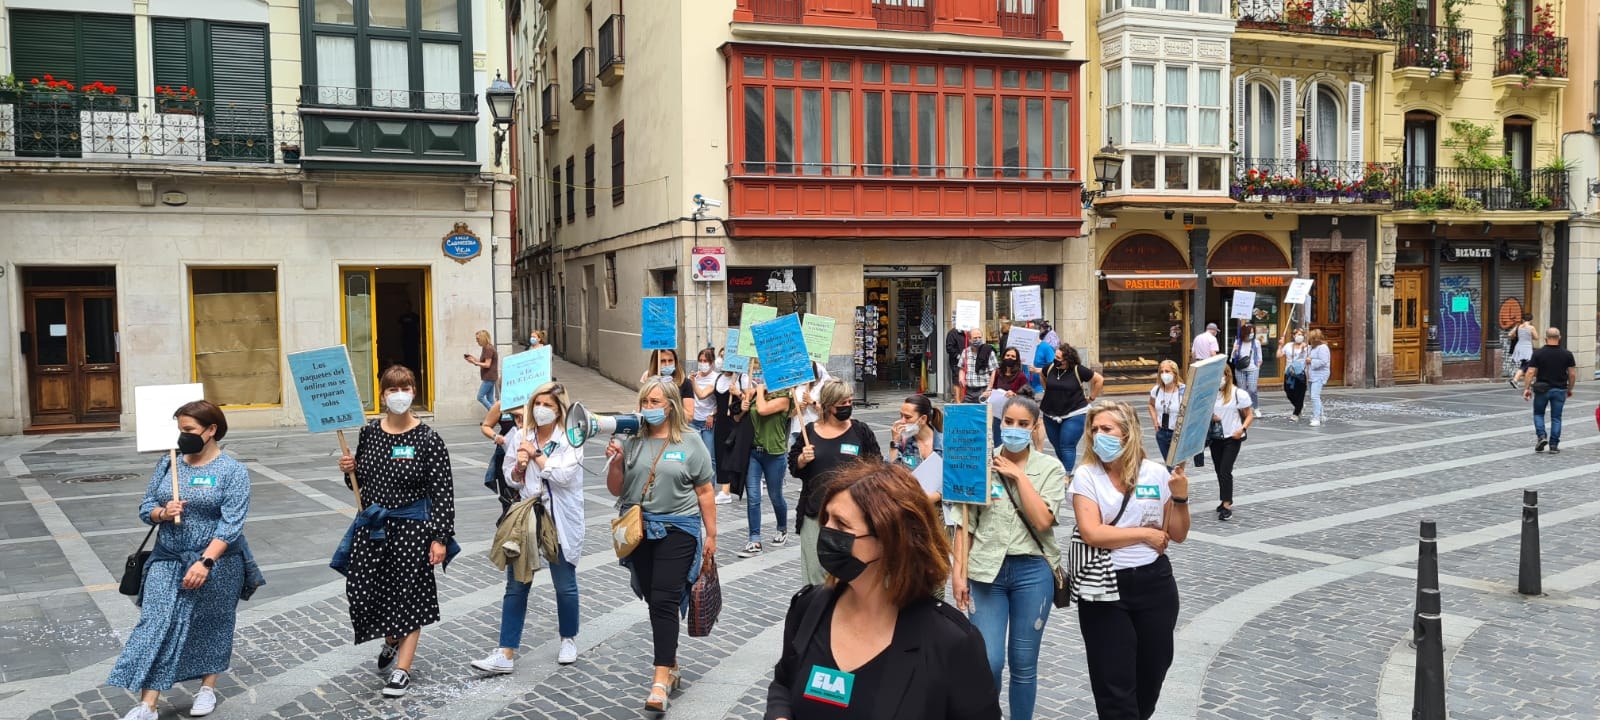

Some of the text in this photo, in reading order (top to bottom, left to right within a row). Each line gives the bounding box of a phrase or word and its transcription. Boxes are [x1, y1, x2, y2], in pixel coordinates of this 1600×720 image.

[1125, 278, 1181, 289] PASTELERIA
[1226, 275, 1284, 286] PAN LEMONA
[312, 362, 326, 370] Los
[299, 367, 345, 383] paquetes del
[304, 382, 326, 391] online
[311, 388, 345, 400] preparan
[321, 400, 340, 408] solas
[1137, 487, 1158, 496] ELA
[811, 671, 846, 695] ELA
